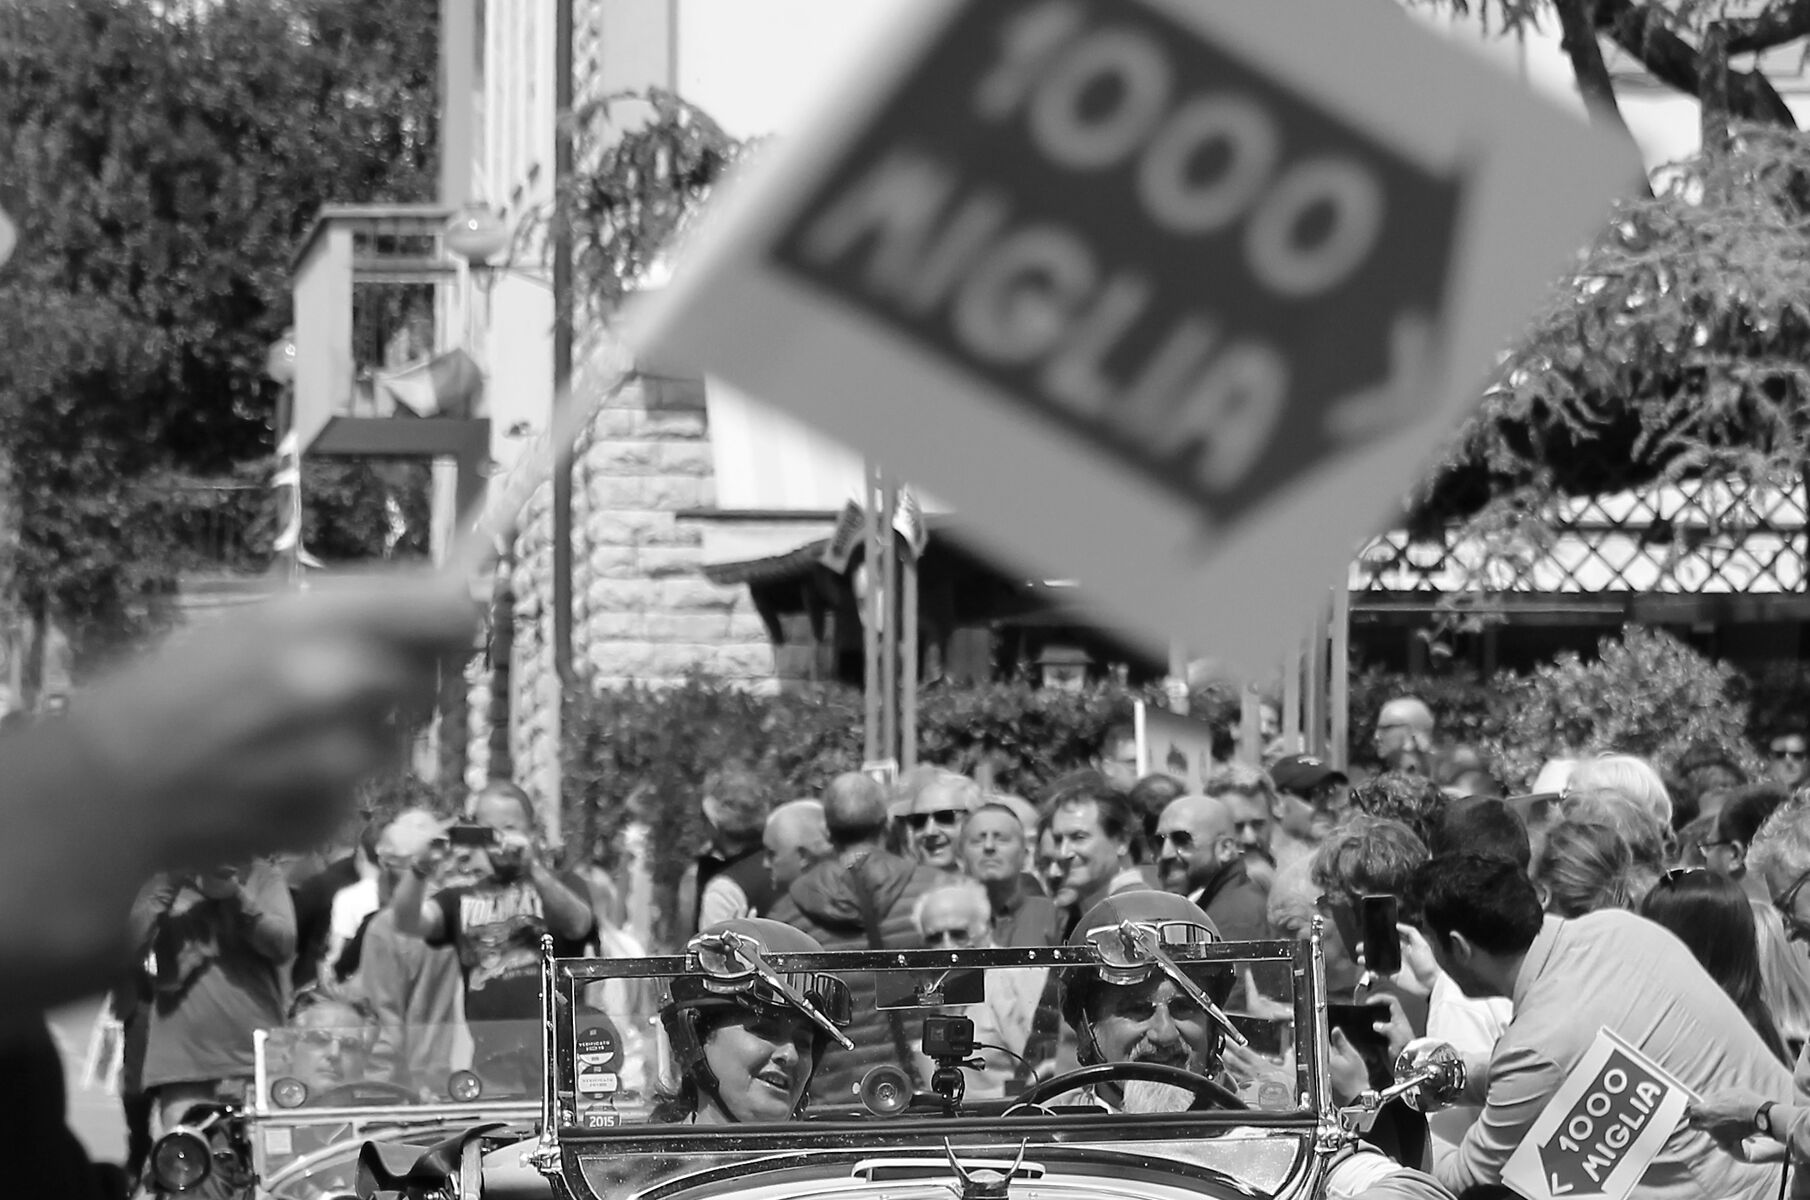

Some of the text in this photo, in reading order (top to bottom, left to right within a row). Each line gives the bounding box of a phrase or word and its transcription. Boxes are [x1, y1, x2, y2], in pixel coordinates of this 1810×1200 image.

[972, 4, 1386, 298] 1000
[804, 146, 1292, 496] MIGLIA
[589, 1115, 615, 1128] 2015
[1558, 1068, 1628, 1152] 1000
[1581, 1080, 1663, 1183] MIGLIA
